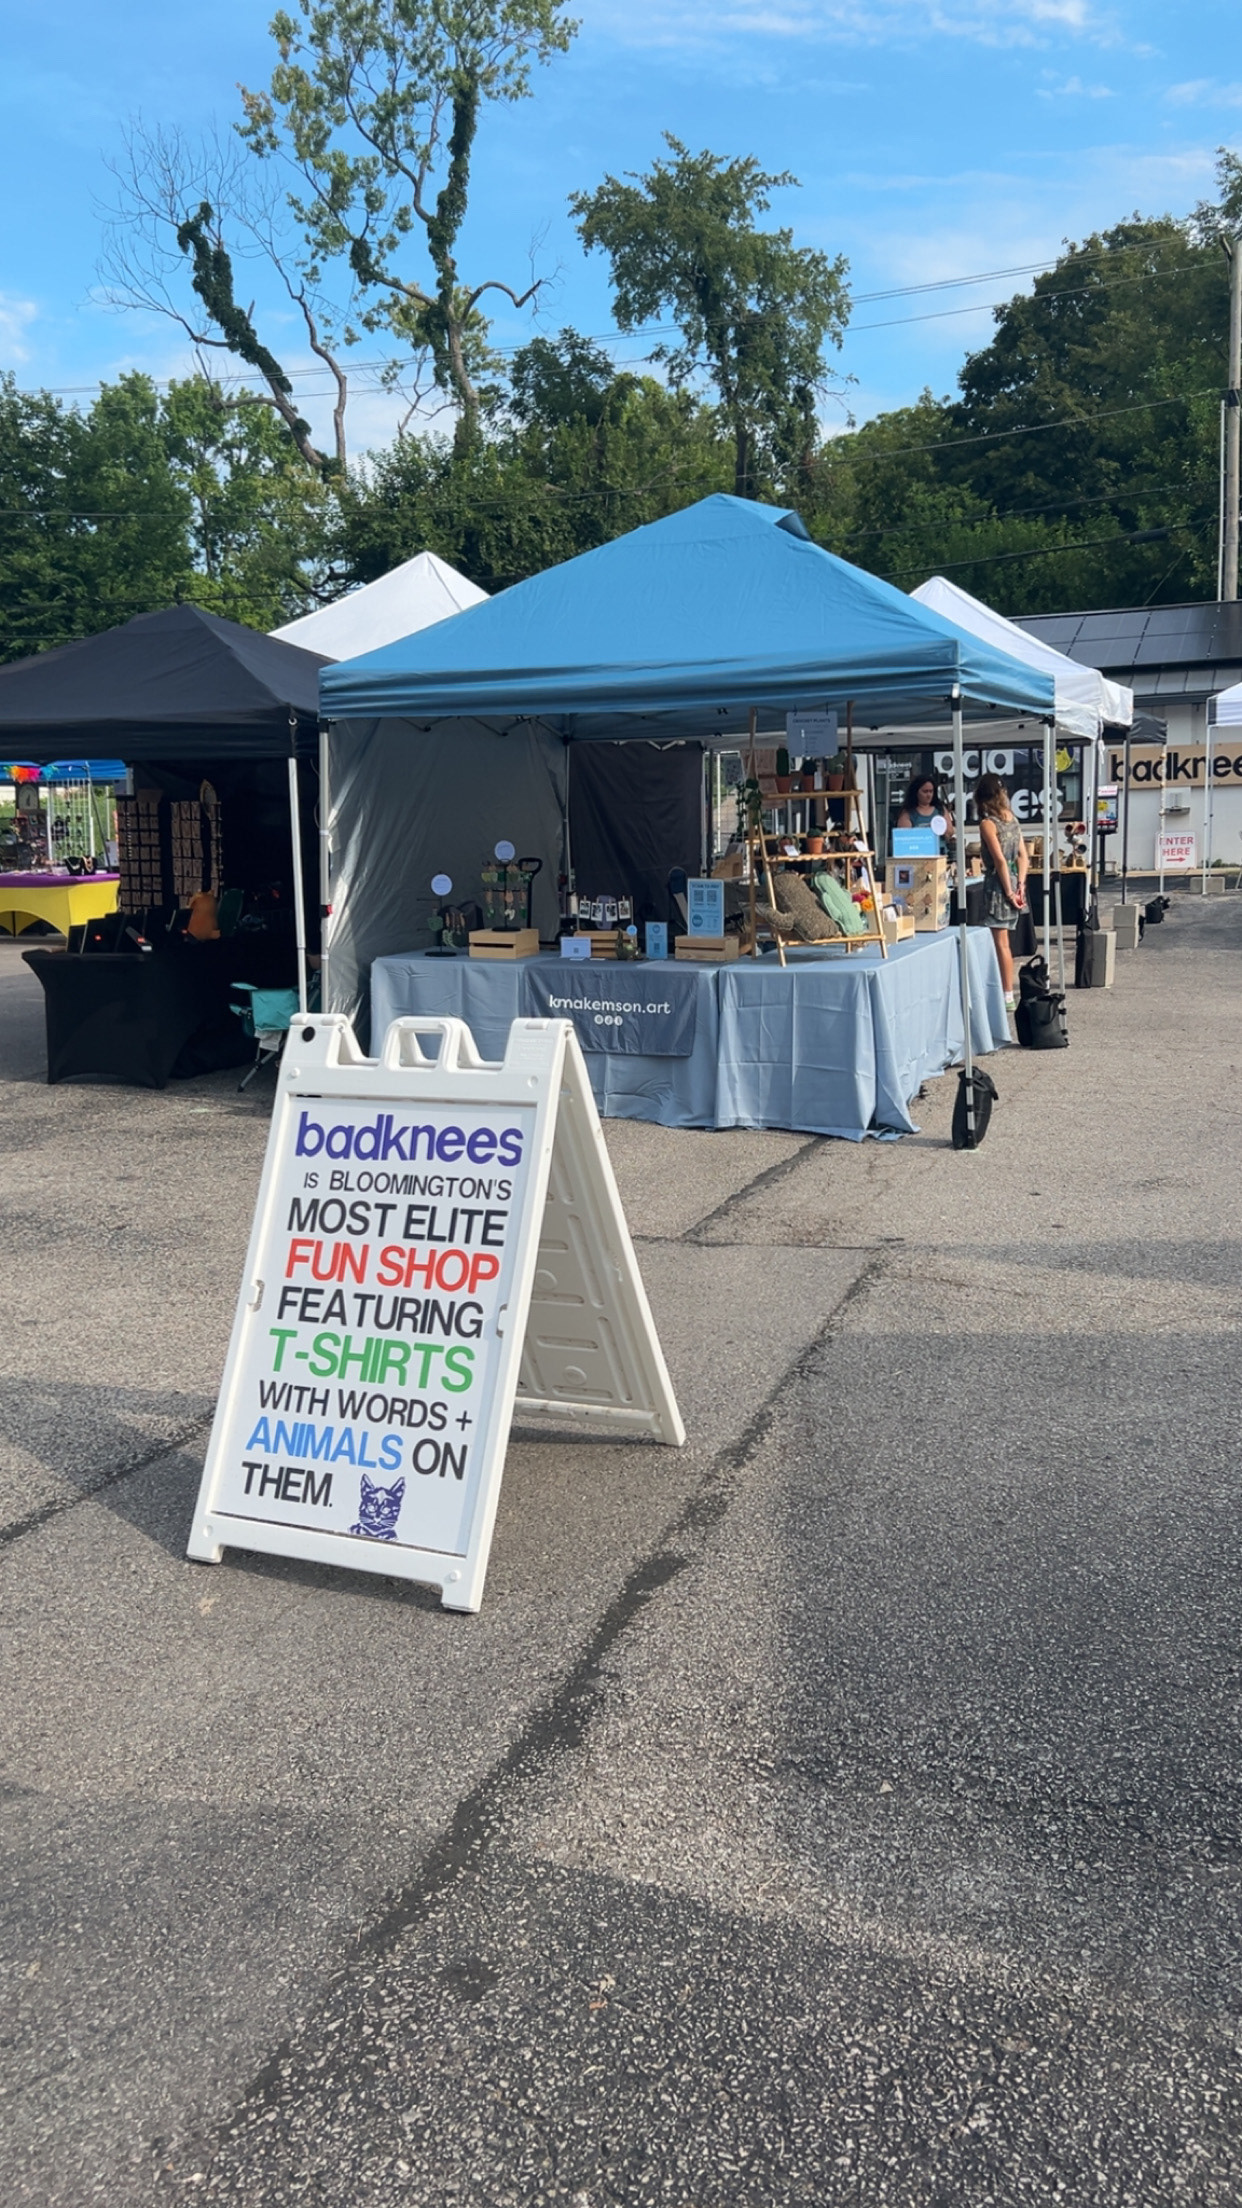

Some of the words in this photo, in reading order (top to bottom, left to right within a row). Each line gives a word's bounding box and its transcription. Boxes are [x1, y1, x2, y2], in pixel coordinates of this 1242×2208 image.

[1162, 847, 1191, 856] HERE
[549, 994, 671, 1014] kmakemson.art
[295, 1111, 524, 1167] badknees
[303, 1172, 319, 1189] IS
[329, 1170, 512, 1201] BLOOMINGTON'S
[287, 1197, 397, 1238] MOST
[402, 1203, 508, 1247] ELITE
[284, 1238, 370, 1284] FUN
[376, 1245, 500, 1294] SHOP
[276, 1285, 484, 1338] FEATURING
[269, 1328, 475, 1393] T-SHIRTS
[259, 1379, 330, 1416] WITH
[337, 1388, 449, 1431] WORDS
[245, 1416, 404, 1471] ANIMALS
[412, 1438, 468, 1481] ON
[241, 1461, 333, 1507] THEM.
